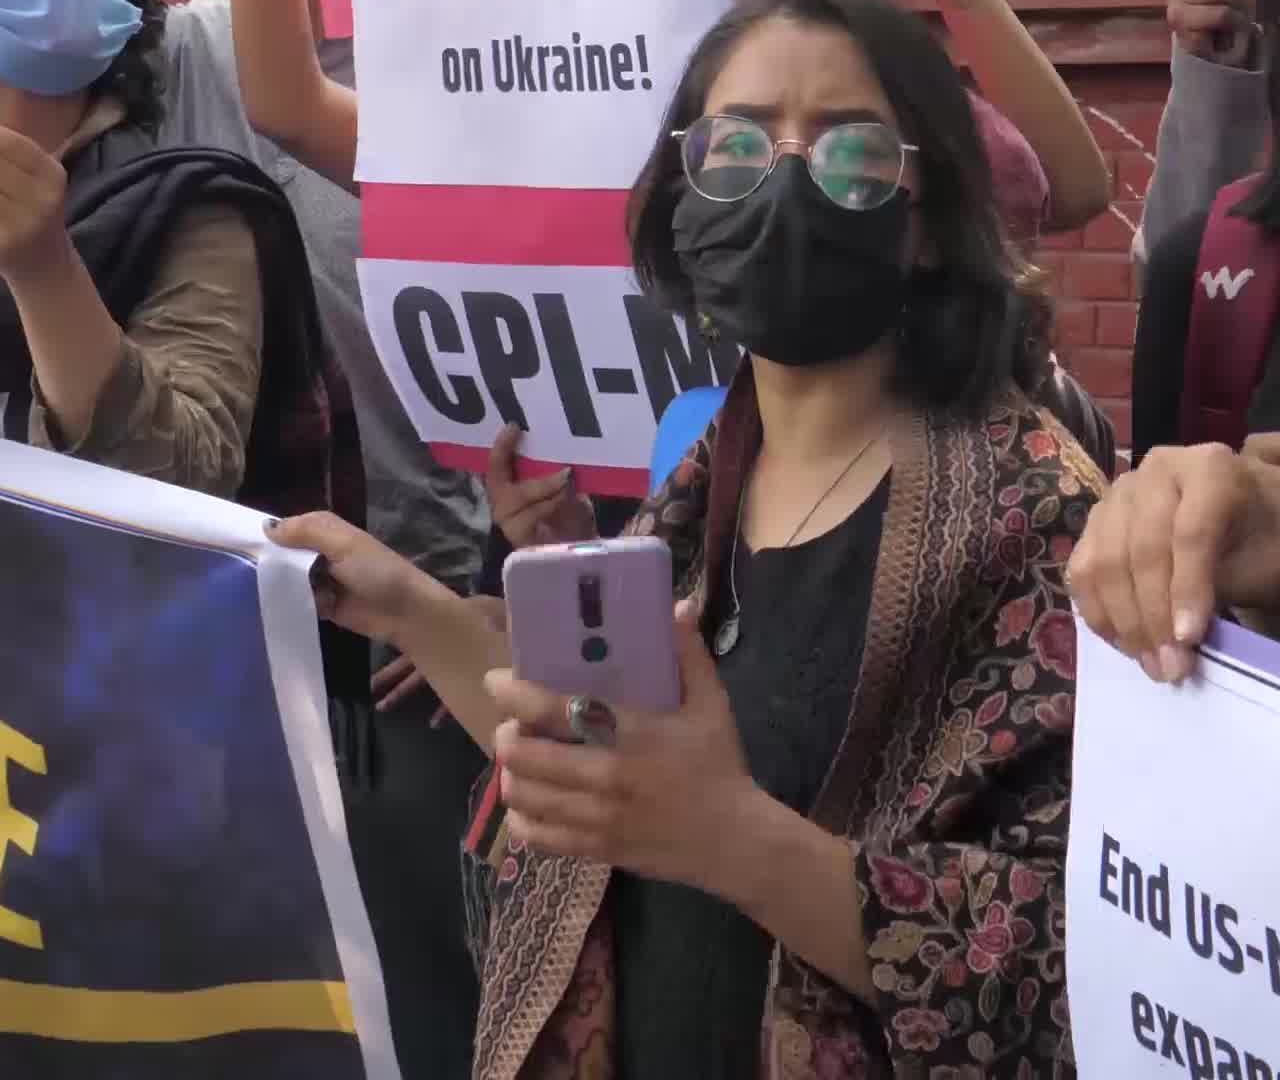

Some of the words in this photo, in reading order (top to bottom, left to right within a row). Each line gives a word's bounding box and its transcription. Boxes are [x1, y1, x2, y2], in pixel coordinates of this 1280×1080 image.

[441, 44, 483, 93] on
[490, 32, 652, 94] Ukraine!
[1099, 832, 1172, 939] End
